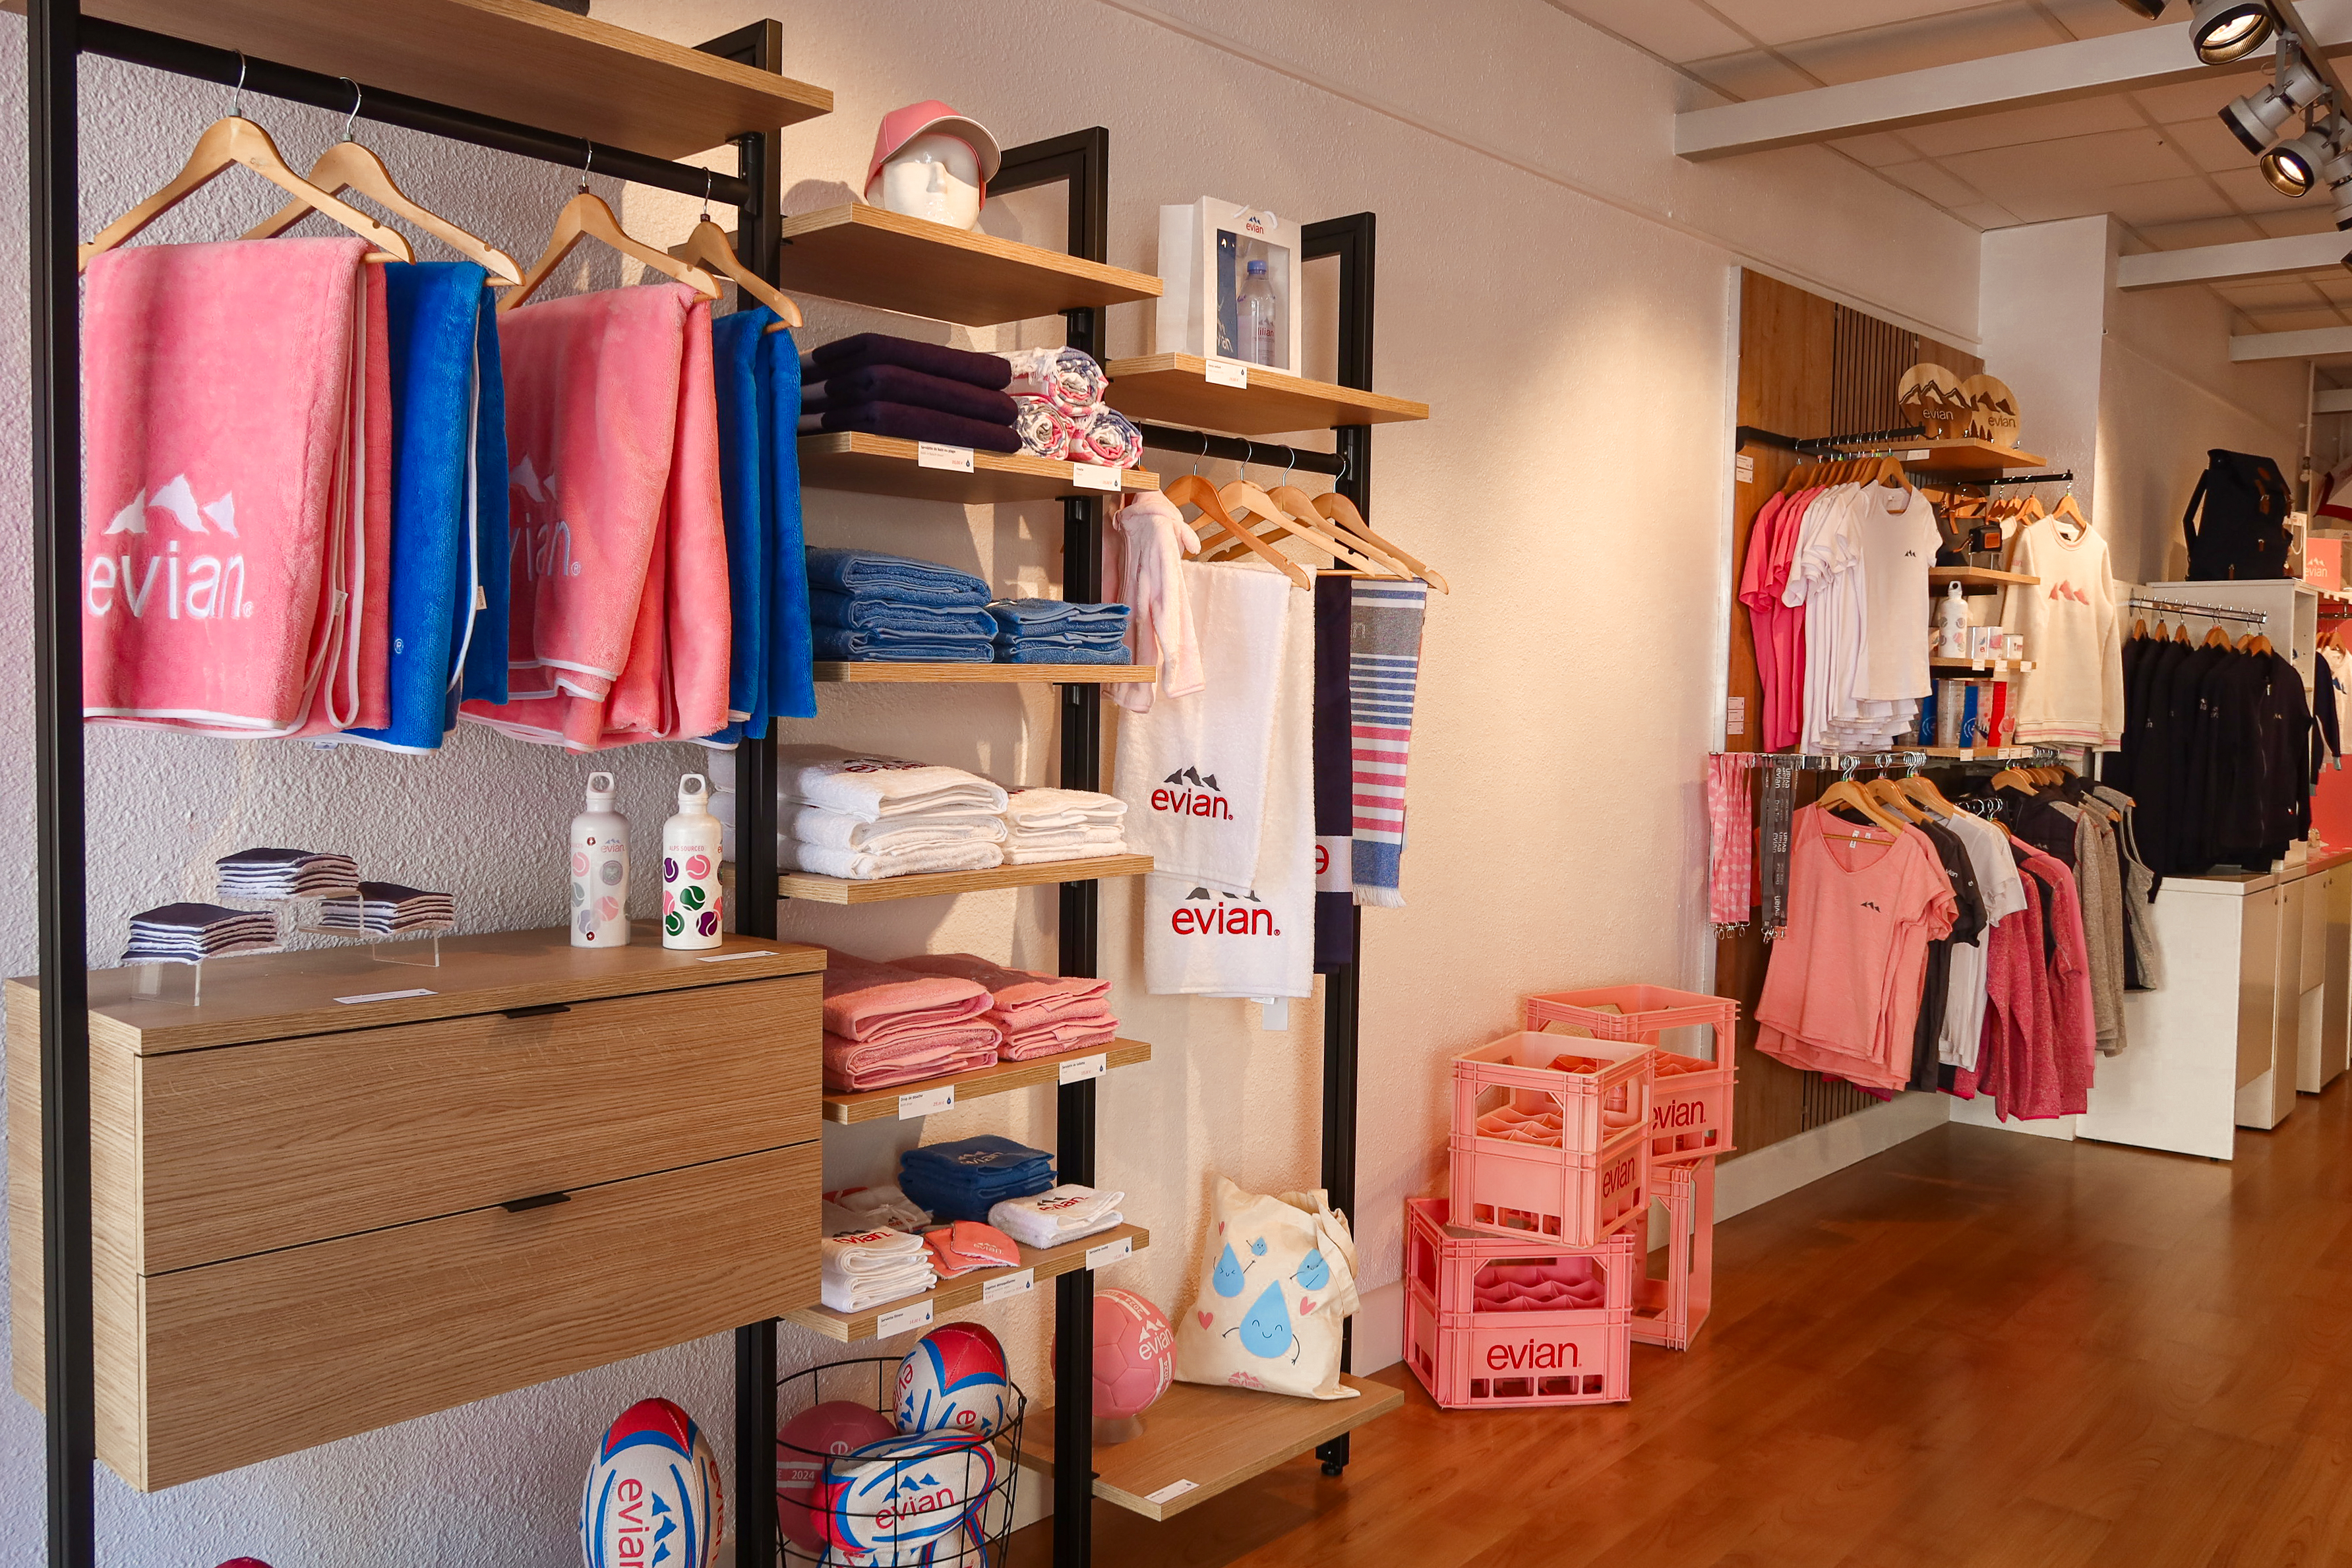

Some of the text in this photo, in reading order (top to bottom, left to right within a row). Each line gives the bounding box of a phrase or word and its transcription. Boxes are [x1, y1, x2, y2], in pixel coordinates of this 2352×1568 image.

[1246, 222, 1264, 234] evian
[1923, 409, 1954, 421] evian
[1988, 415, 2016, 427] evian
[2305, 566, 2328, 577] evian
[86, 540, 246, 620] evian
[1151, 788, 1230, 820] evian
[601, 844, 625, 853] evian
[1946, 868, 1958, 878] vian
[1172, 901, 1273, 936] evian
[1603, 1157, 1635, 1197] evian
[973, 1243, 1002, 1255] evian
[1126, 1298, 1143, 1314] 2024
[1139, 1328, 1174, 1360] evian
[1486, 1338, 1579, 1370] evian
[791, 1470, 815, 1480] 2024
[875, 1488, 955, 1529] evian
